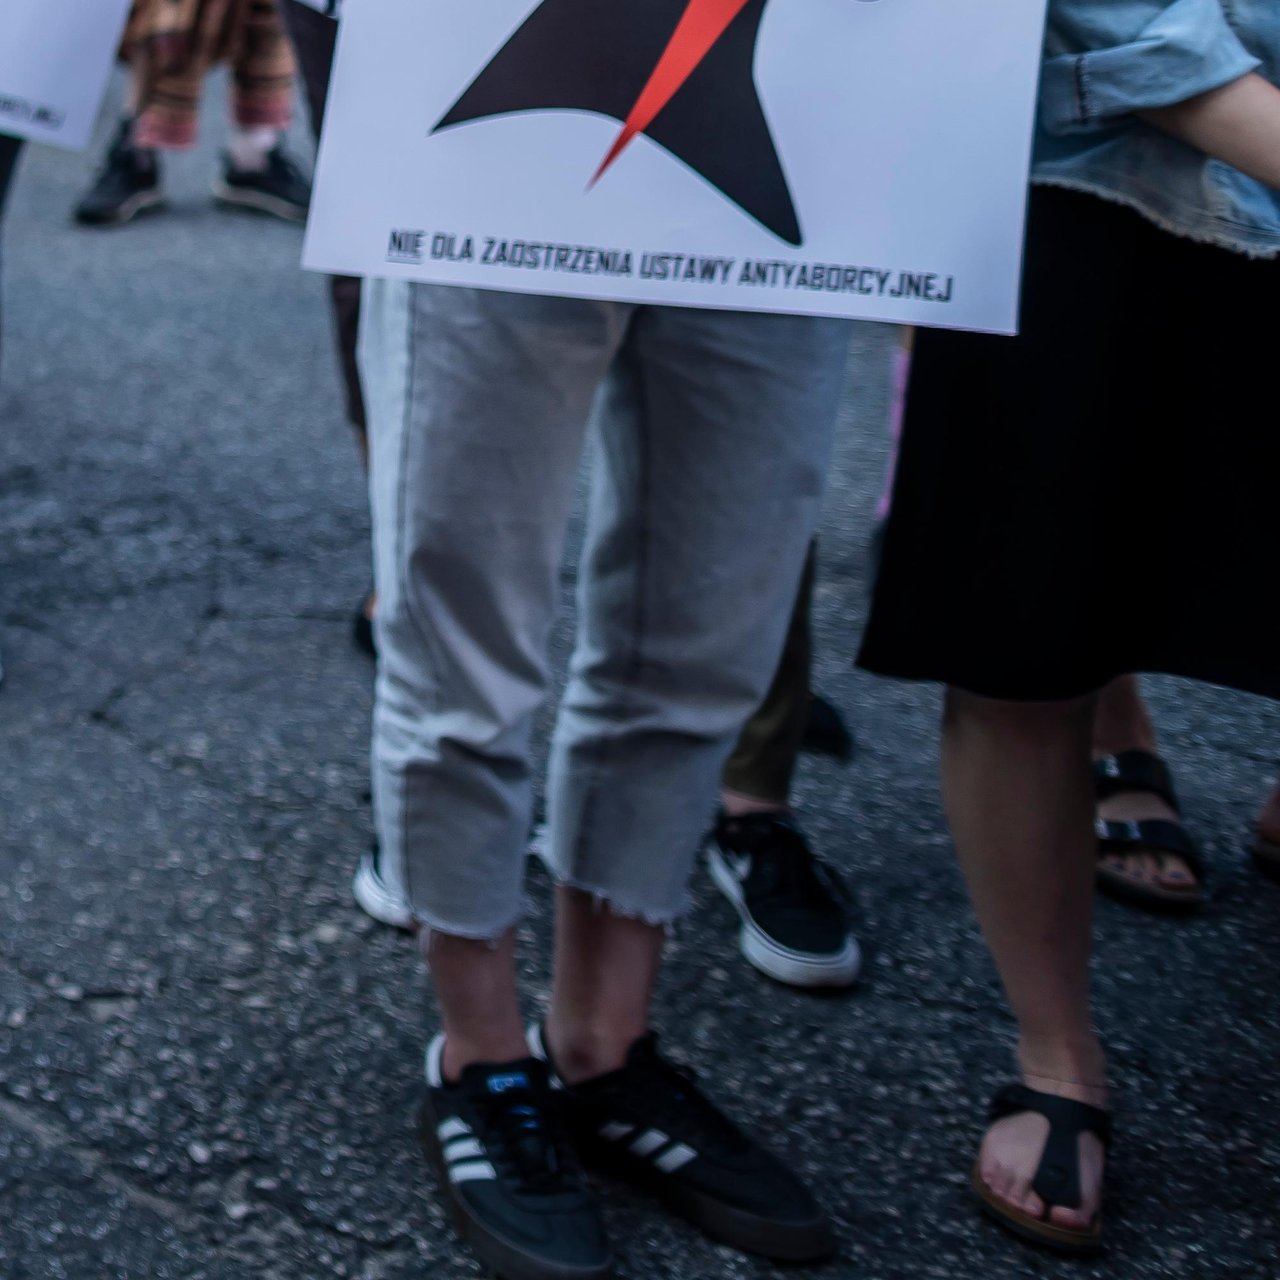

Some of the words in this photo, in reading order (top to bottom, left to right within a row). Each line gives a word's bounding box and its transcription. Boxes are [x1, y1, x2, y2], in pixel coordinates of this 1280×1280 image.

[389, 228, 426, 258] NIE
[430, 231, 474, 261] DLA
[479, 235, 633, 277] ZAOSTRZENIA
[639, 251, 735, 285] USTAWY
[737, 256, 954, 302] ANTYABORCYJNEJ
